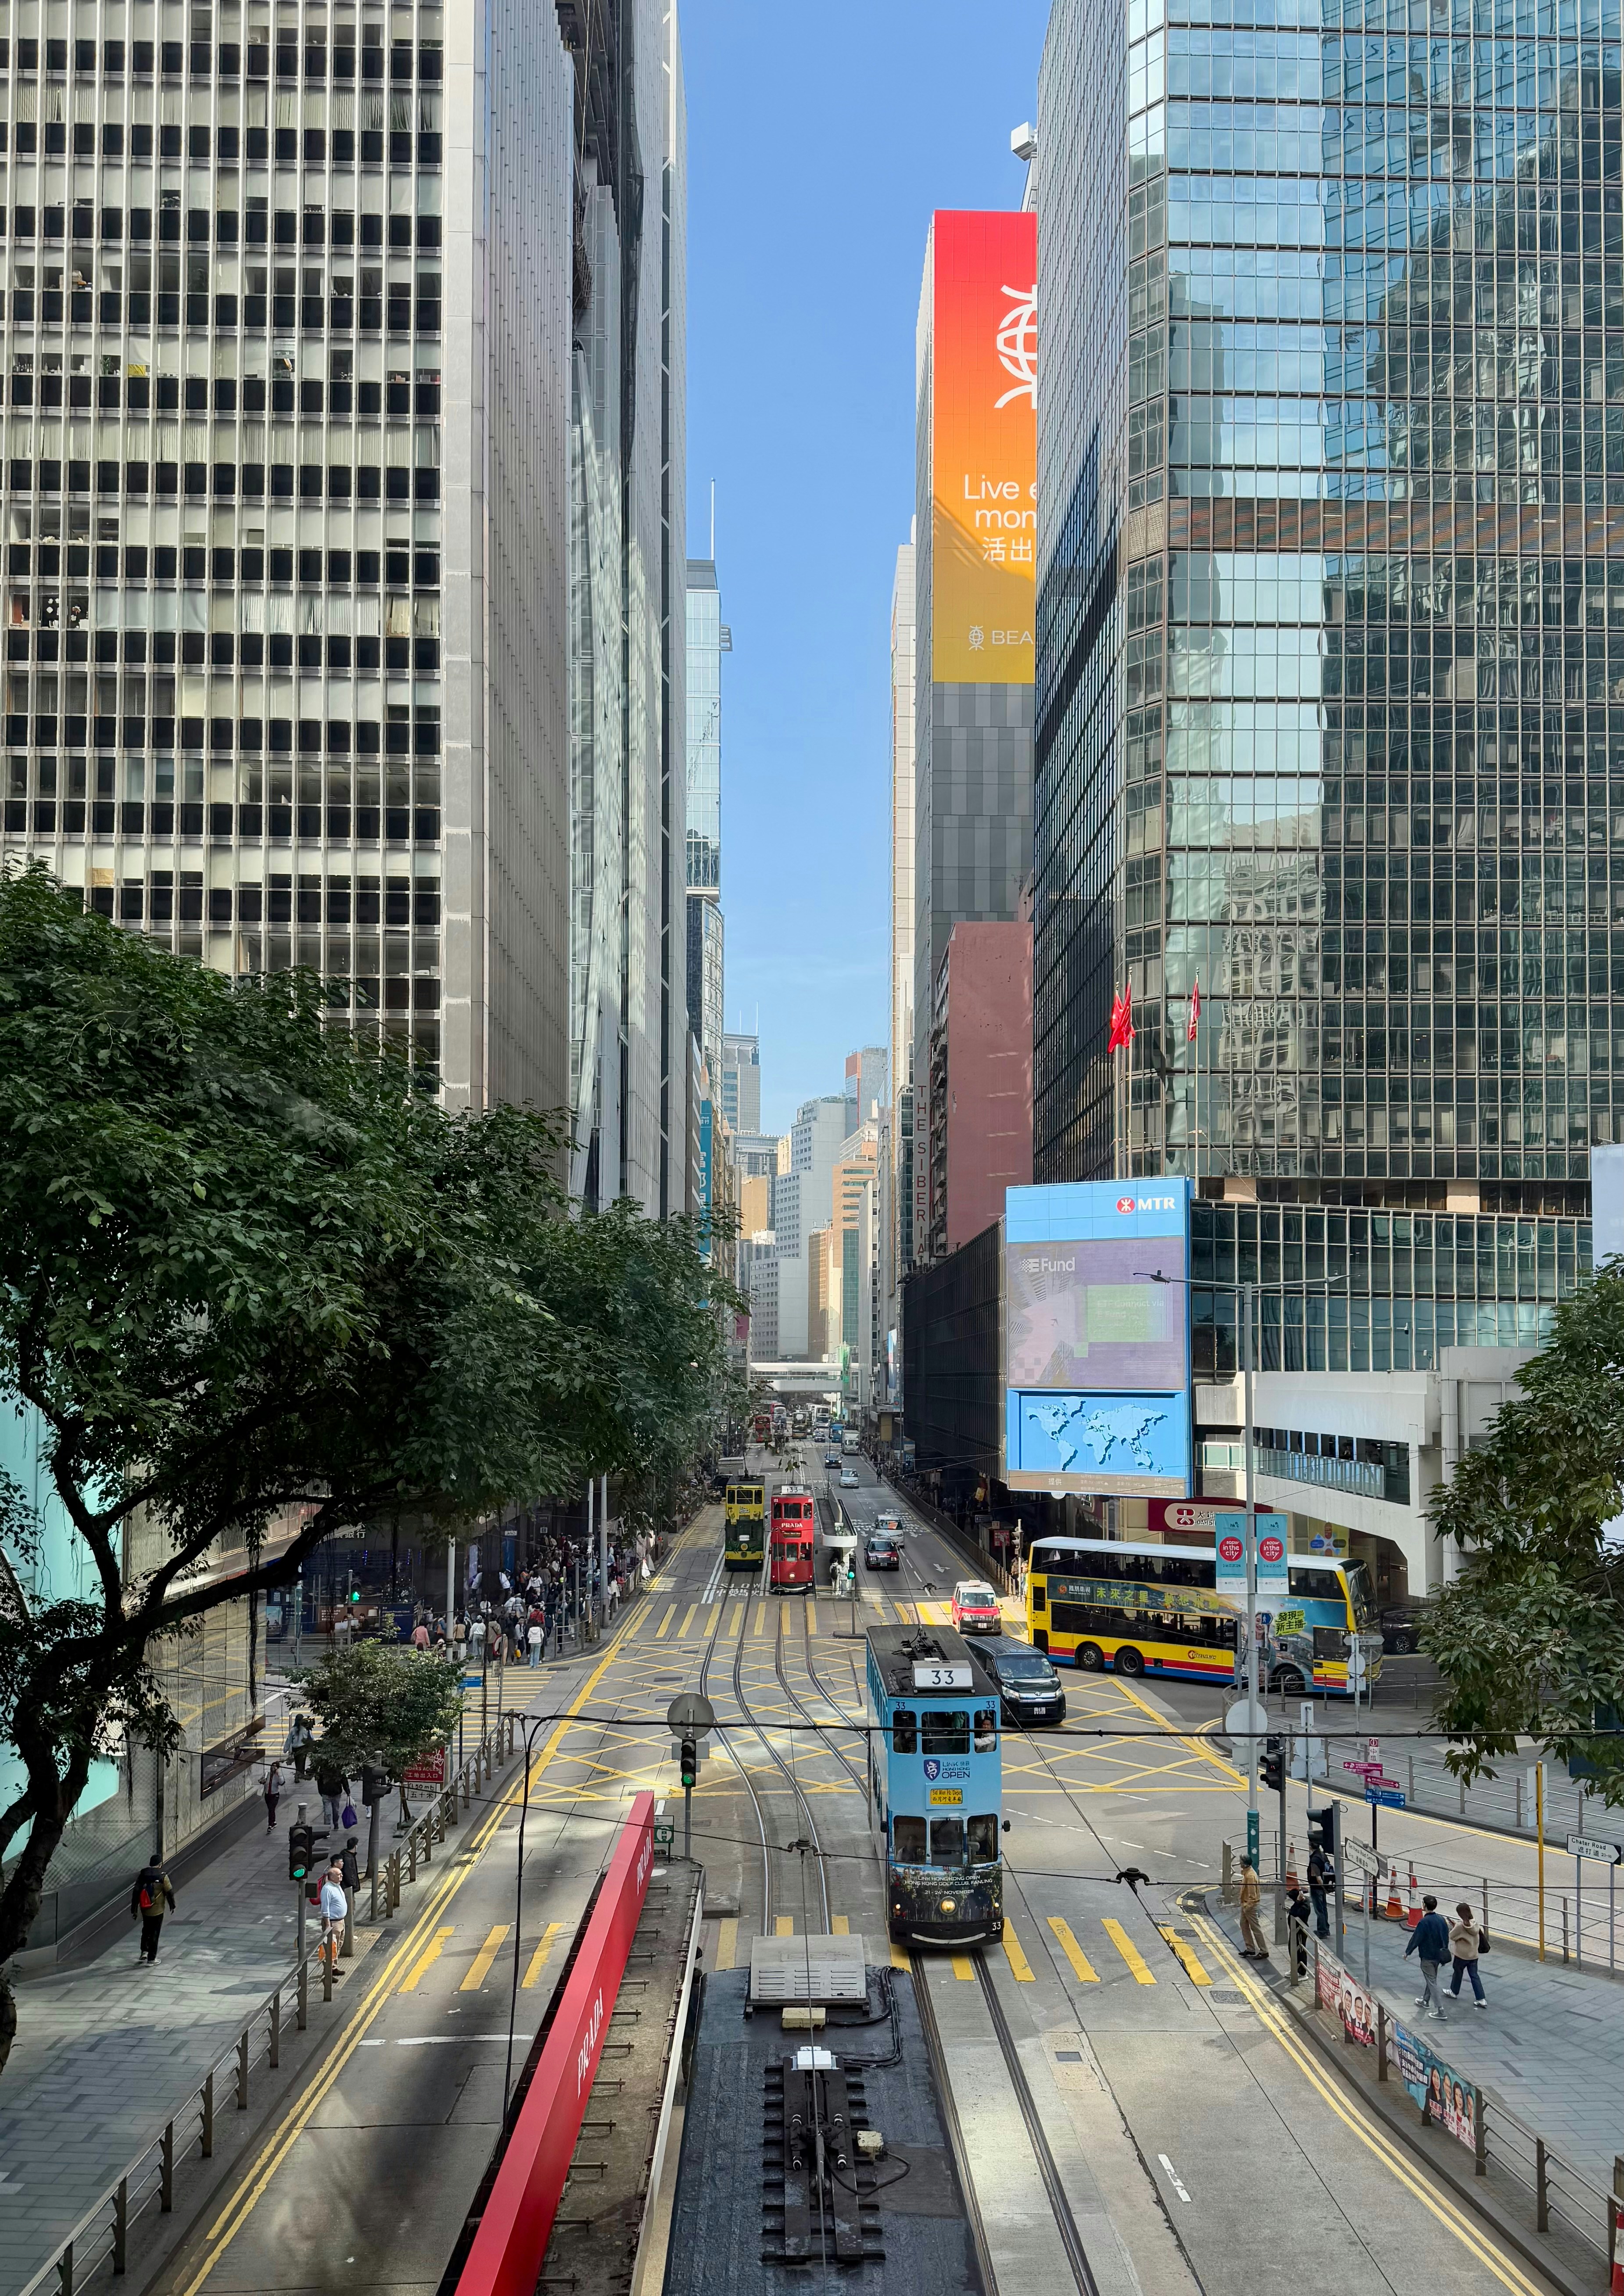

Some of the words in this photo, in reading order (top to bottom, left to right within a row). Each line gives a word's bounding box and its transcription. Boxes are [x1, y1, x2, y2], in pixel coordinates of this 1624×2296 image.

[964, 474, 1020, 500] Live
[982, 537, 1032, 562] 活出
[992, 630, 1034, 645] BEA
[917, 1085, 926, 1131] THE
[1138, 1197, 1176, 1211] MTR
[1041, 1257, 1075, 1272] Fund
[1226, 1551, 1239, 1559] city
[1266, 1551, 1279, 1559] city
[1097, 1587, 1148, 1603] 未來之星
[931, 1670, 954, 1685] 33
[896, 1701, 906, 1710] 33
[986, 1700, 995, 1709] 33
[1571, 1837, 1590, 1846] Chater
[1592, 1842, 1606, 1850] Road
[637, 1829, 652, 1896] PRADA
[992, 1921, 1001, 1931] 33
[577, 1987, 603, 2100] PRADA
